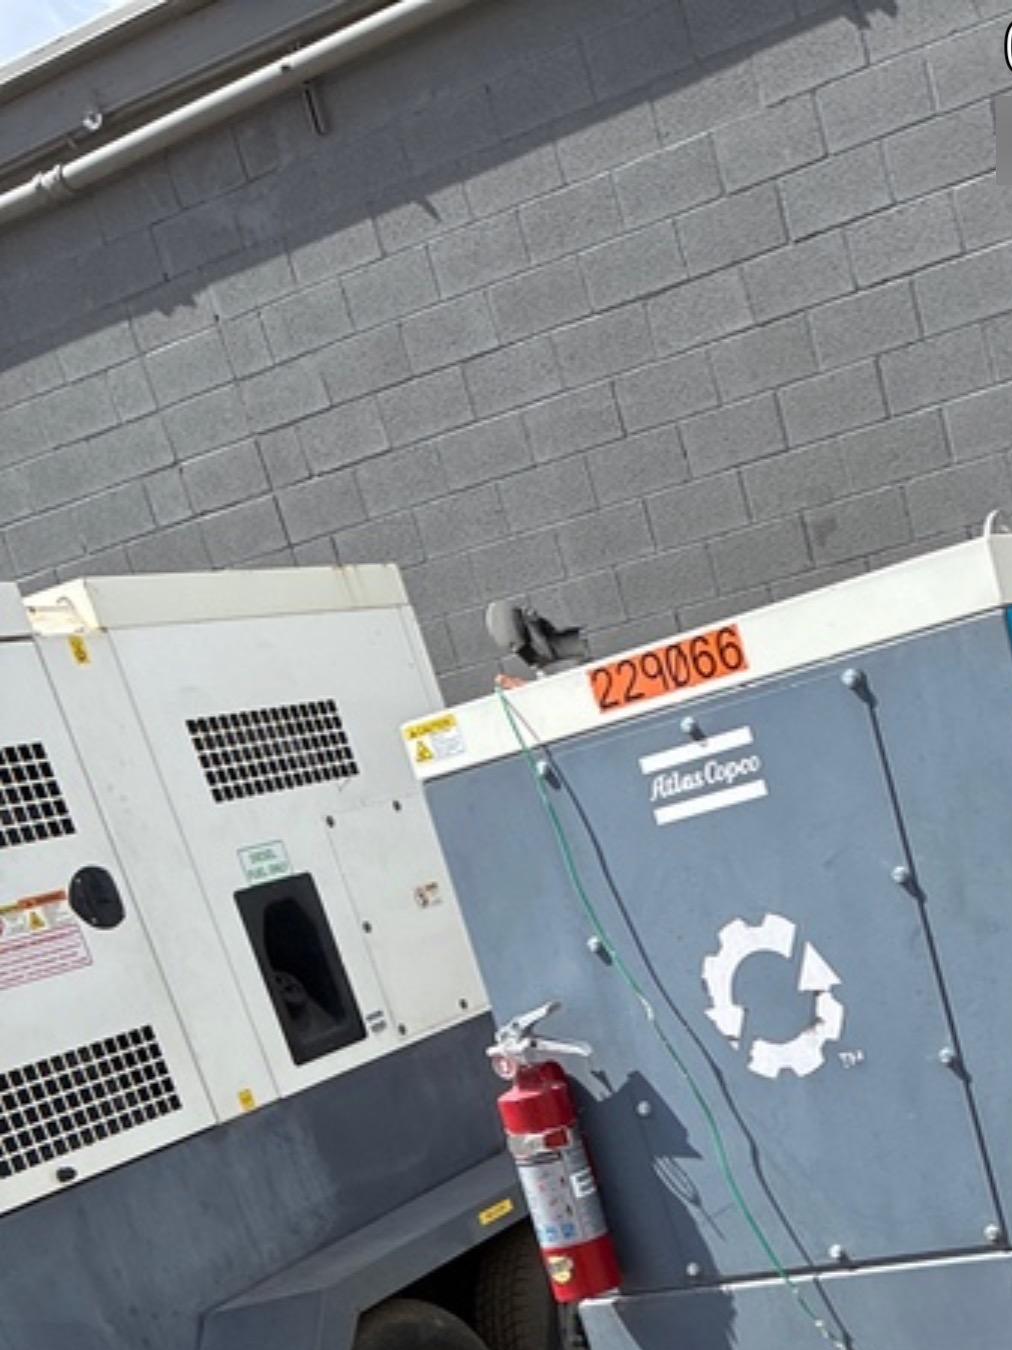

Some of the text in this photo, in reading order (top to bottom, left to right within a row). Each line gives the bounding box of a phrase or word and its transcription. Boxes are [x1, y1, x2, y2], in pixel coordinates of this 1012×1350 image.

[591, 627, 743, 709] 229066
[650, 755, 760, 802] Atlas Copco
